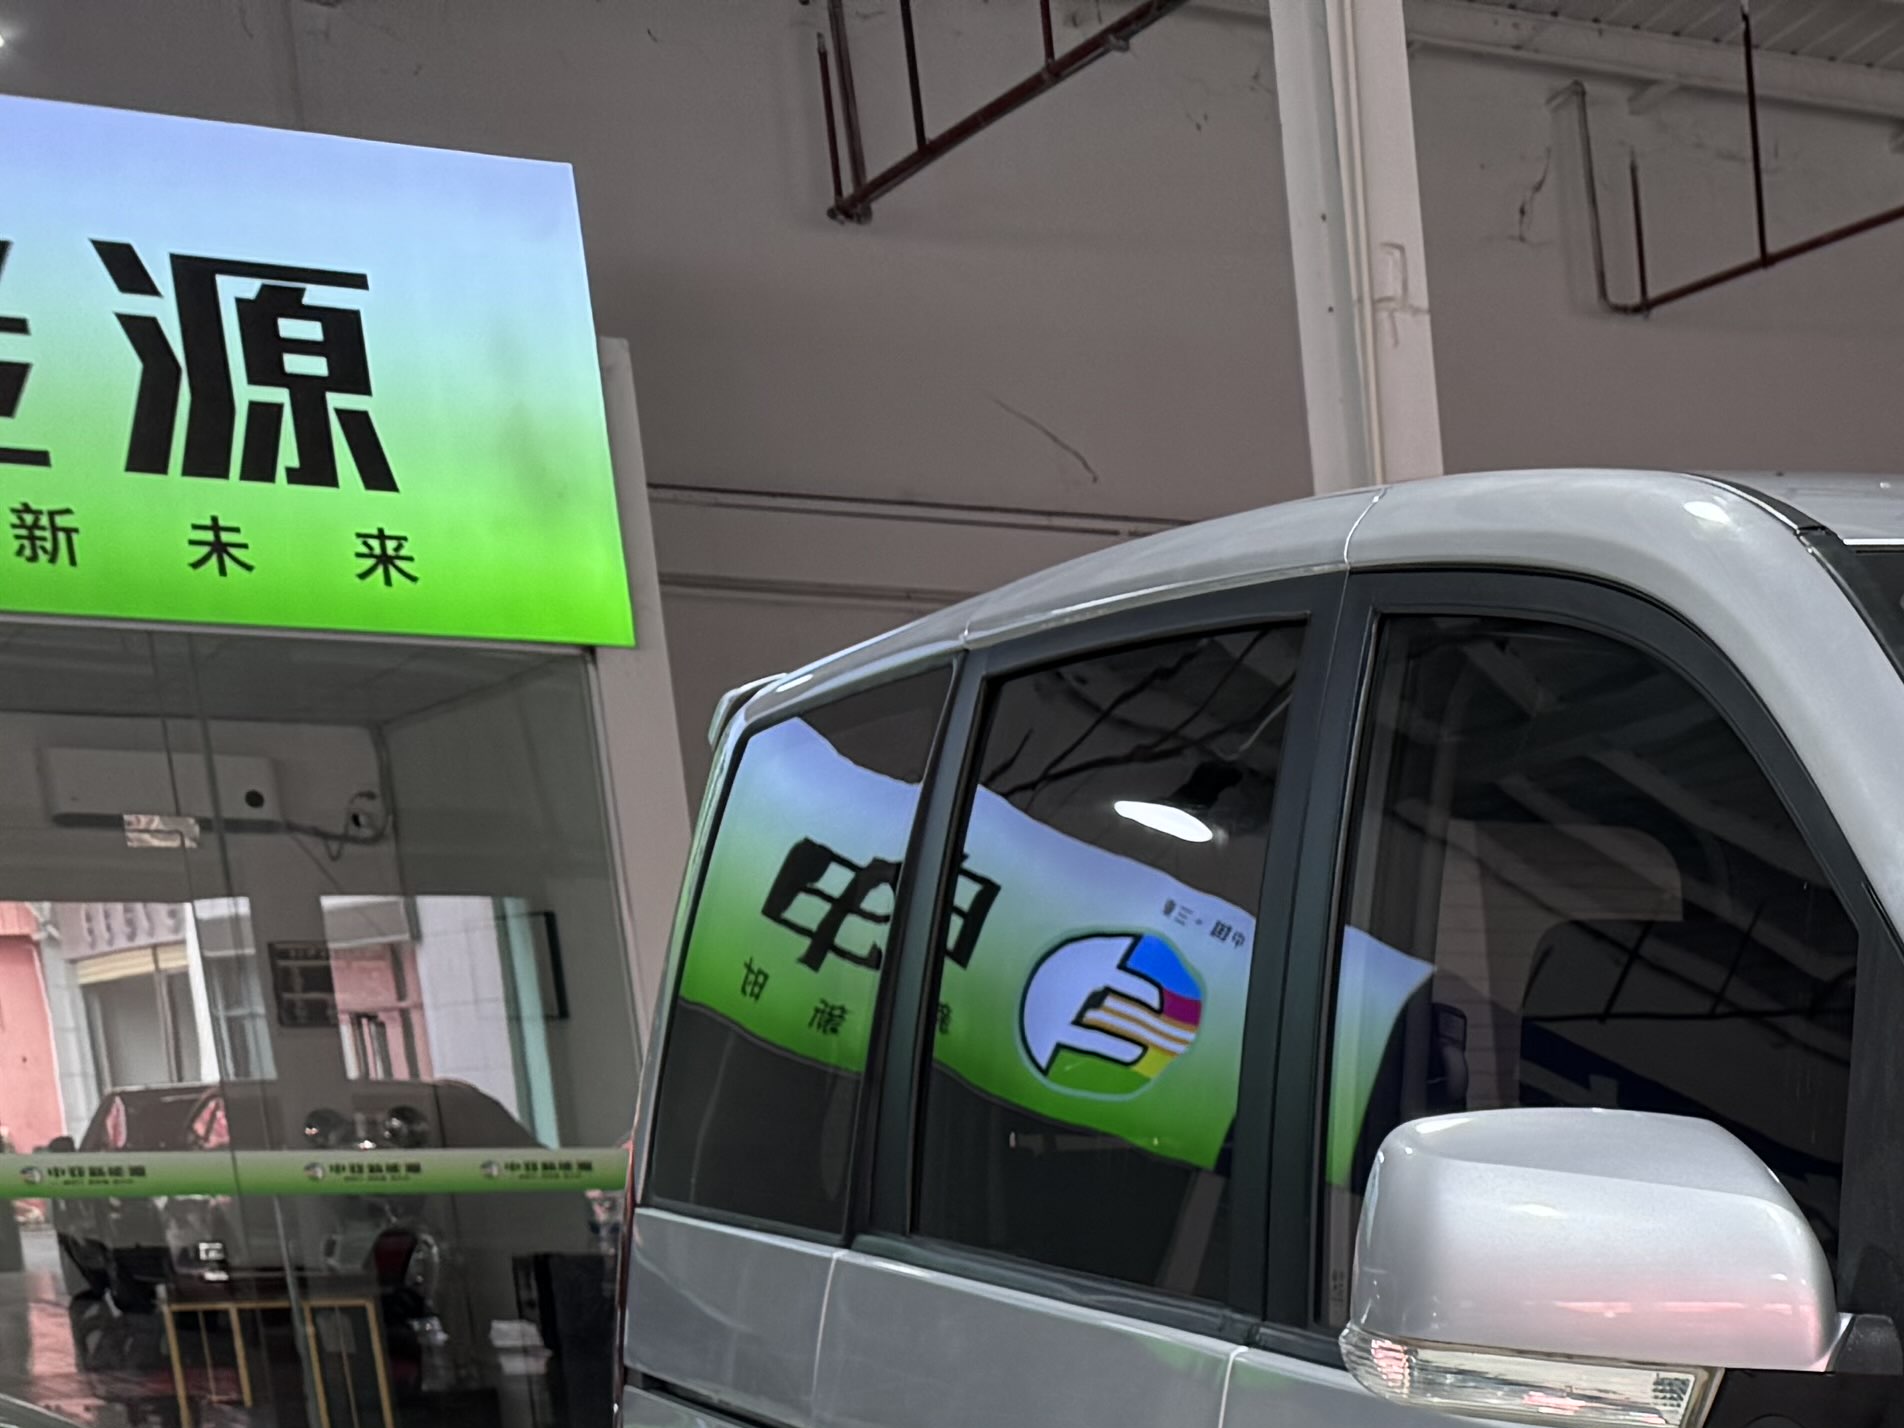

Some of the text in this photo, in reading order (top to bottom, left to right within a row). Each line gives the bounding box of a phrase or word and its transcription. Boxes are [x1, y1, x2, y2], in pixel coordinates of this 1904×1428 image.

[0, 238, 400, 494] 源
[9, 502, 420, 588] 新未来
